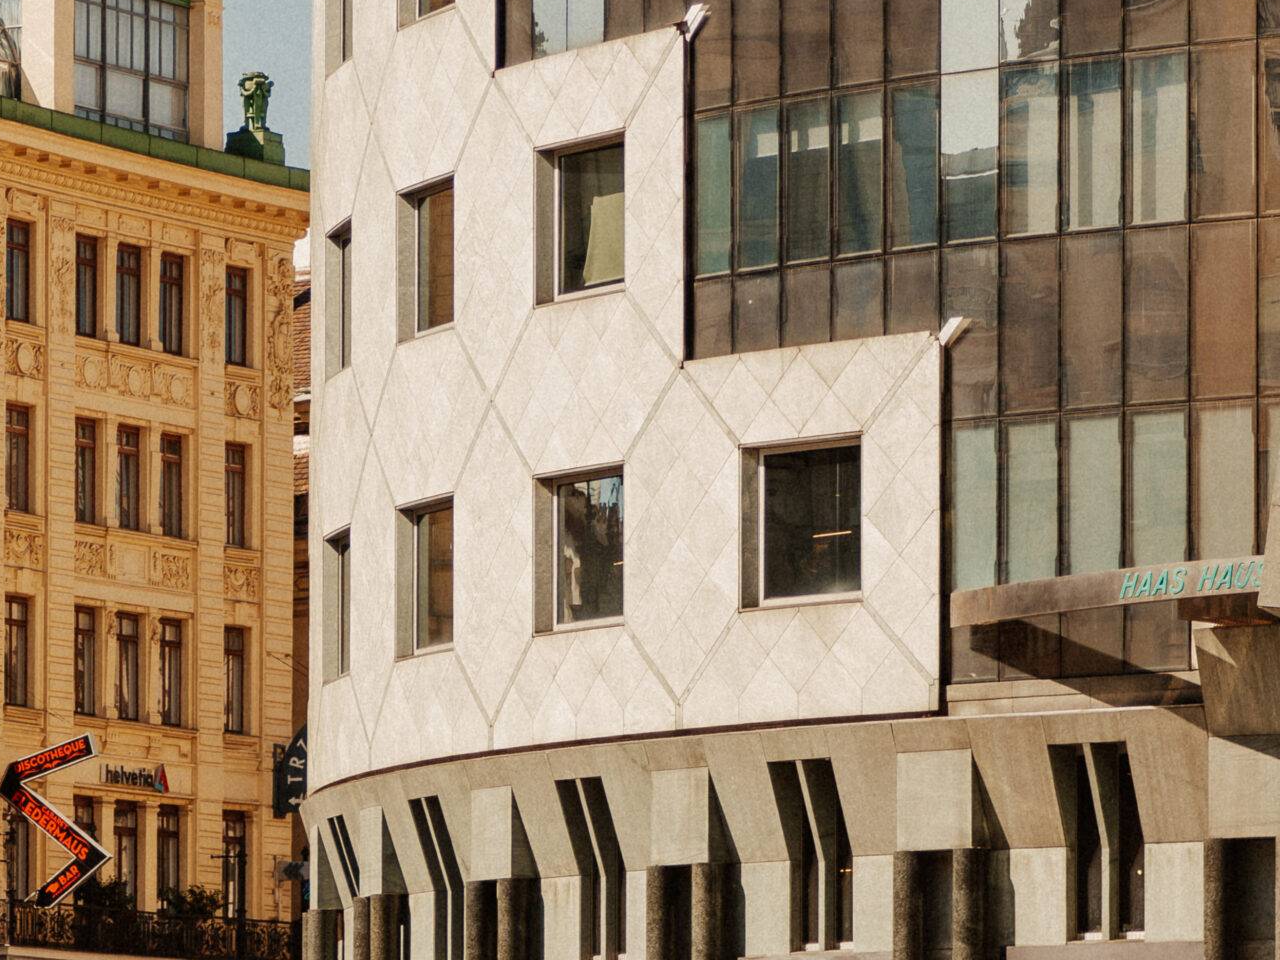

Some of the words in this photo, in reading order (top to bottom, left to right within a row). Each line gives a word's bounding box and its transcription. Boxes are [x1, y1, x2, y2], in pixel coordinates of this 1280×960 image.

[1120, 567, 1187, 598] HAAS
[106, 763, 154, 787] helvetia
[12, 791, 88, 860] FLEDERMAUS
[59, 864, 79, 885] BAR
